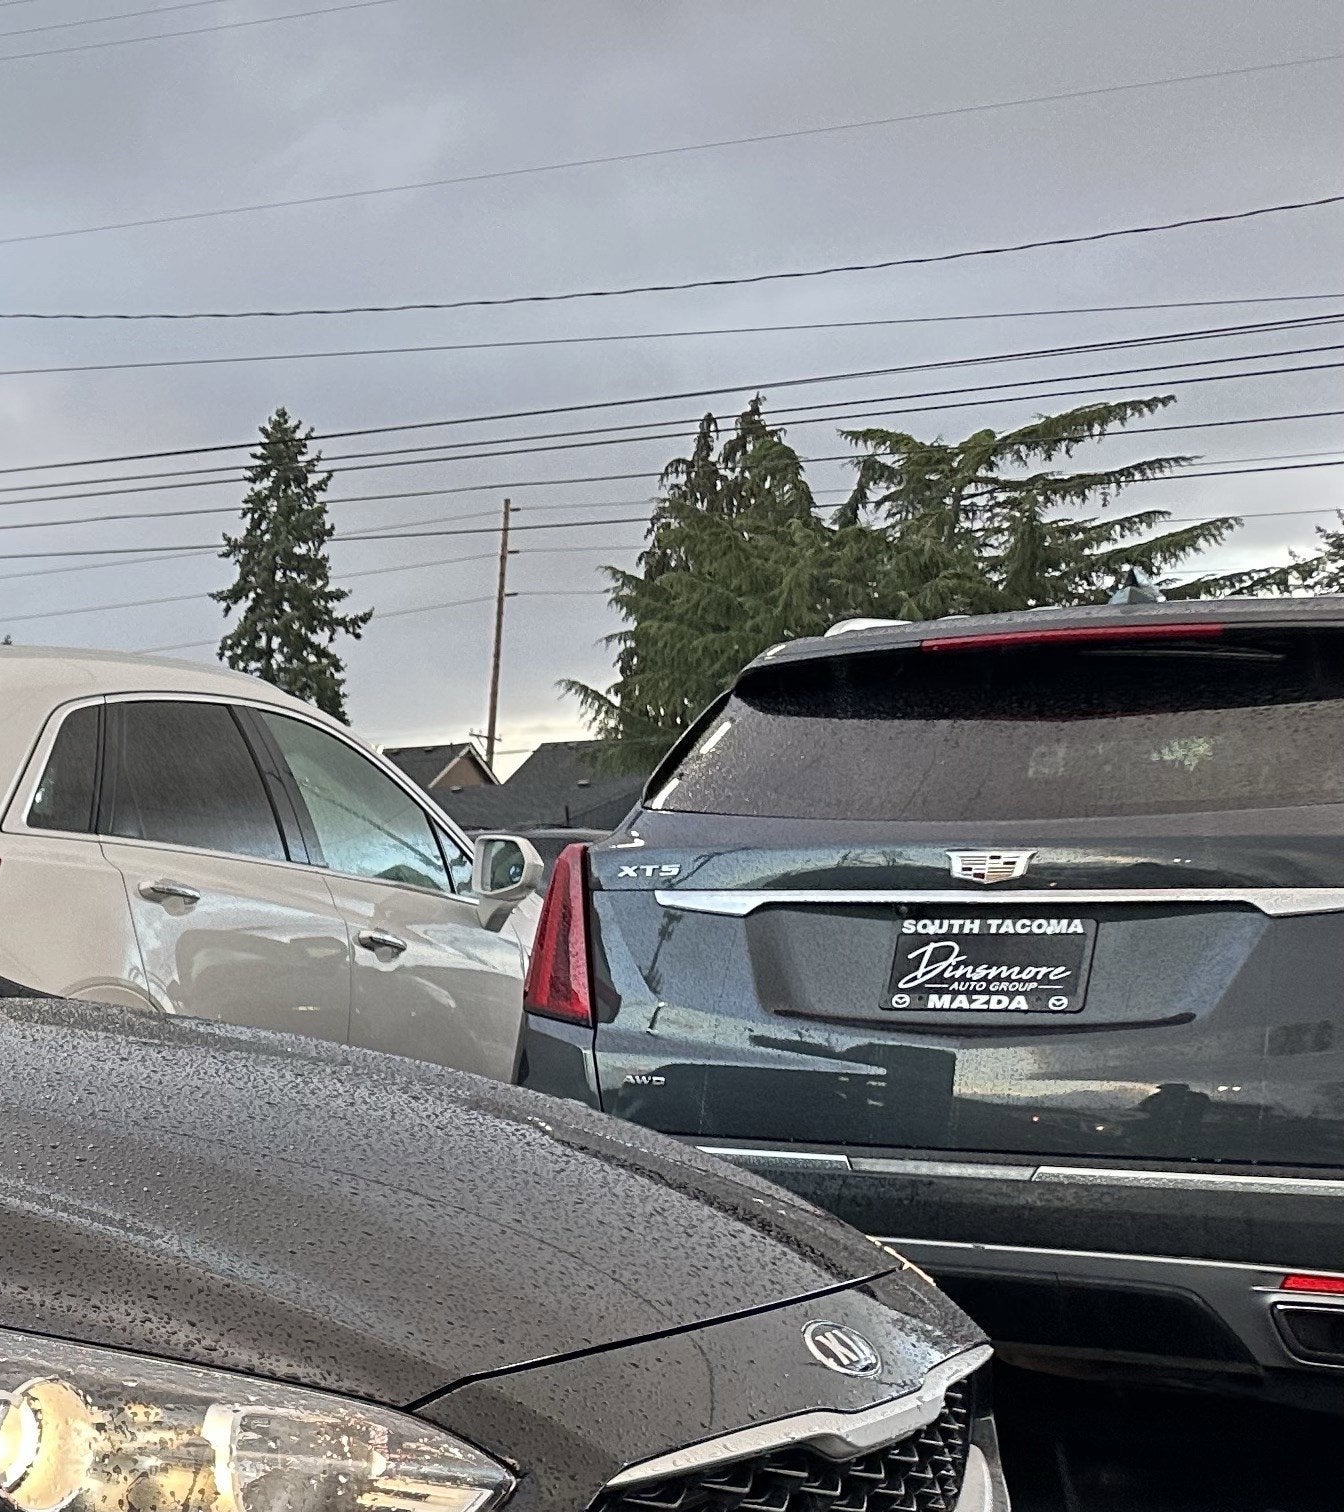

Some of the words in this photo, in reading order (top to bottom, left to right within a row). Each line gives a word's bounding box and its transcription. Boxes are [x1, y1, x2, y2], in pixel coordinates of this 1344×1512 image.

[617, 864, 681, 877] XT5
[902, 919, 981, 935] SOUTH
[987, 919, 1084, 935] TACOMA
[898, 941, 1071, 989] Dinsmore
[949, 981, 986, 992] AUTO
[989, 981, 1038, 992] GROUP
[927, 994, 1029, 1010] MAZDA
[623, 1074, 666, 1086] AWD
